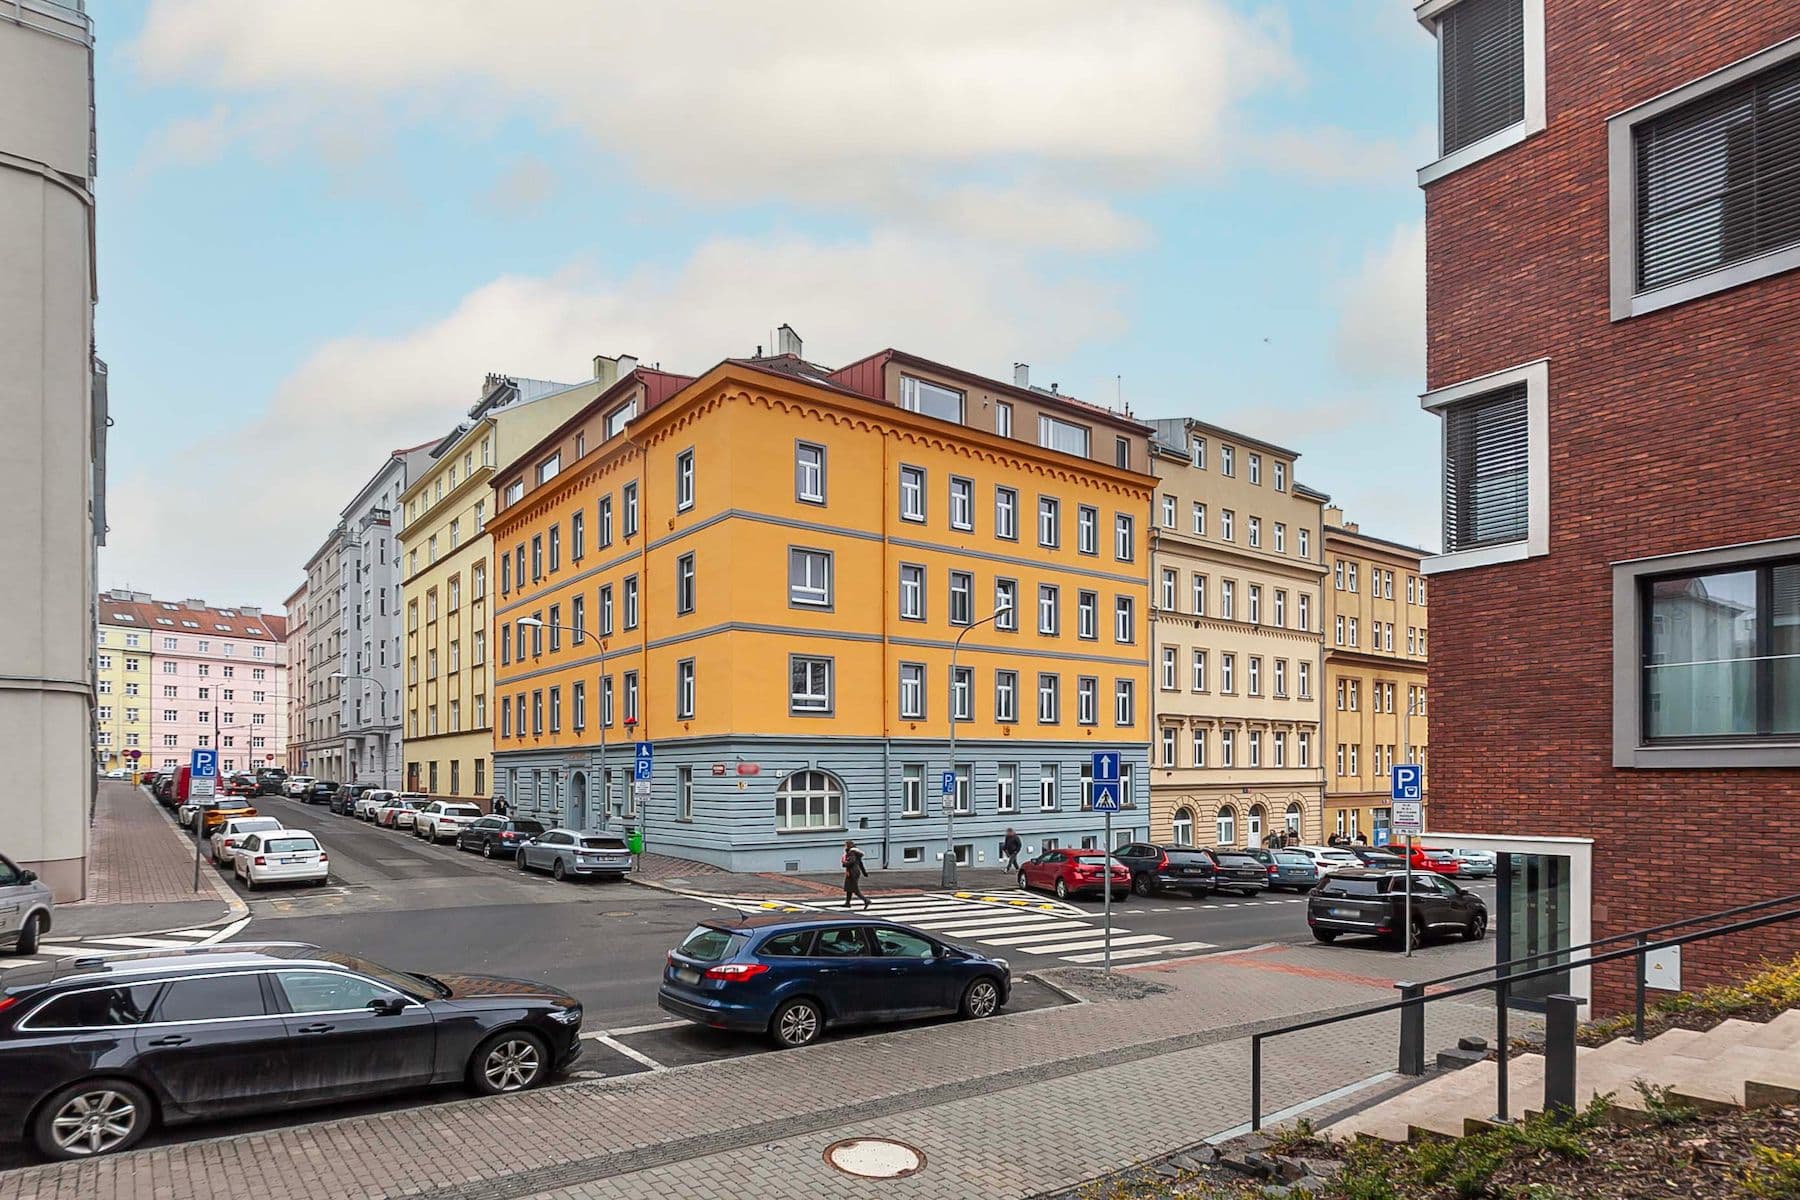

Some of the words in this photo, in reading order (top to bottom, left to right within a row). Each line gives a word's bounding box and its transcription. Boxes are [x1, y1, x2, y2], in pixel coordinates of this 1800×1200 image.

[197, 753, 212, 769] P
[638, 761, 648, 774] P
[945, 774, 953, 787] P
[1398, 769, 1415, 789] P
